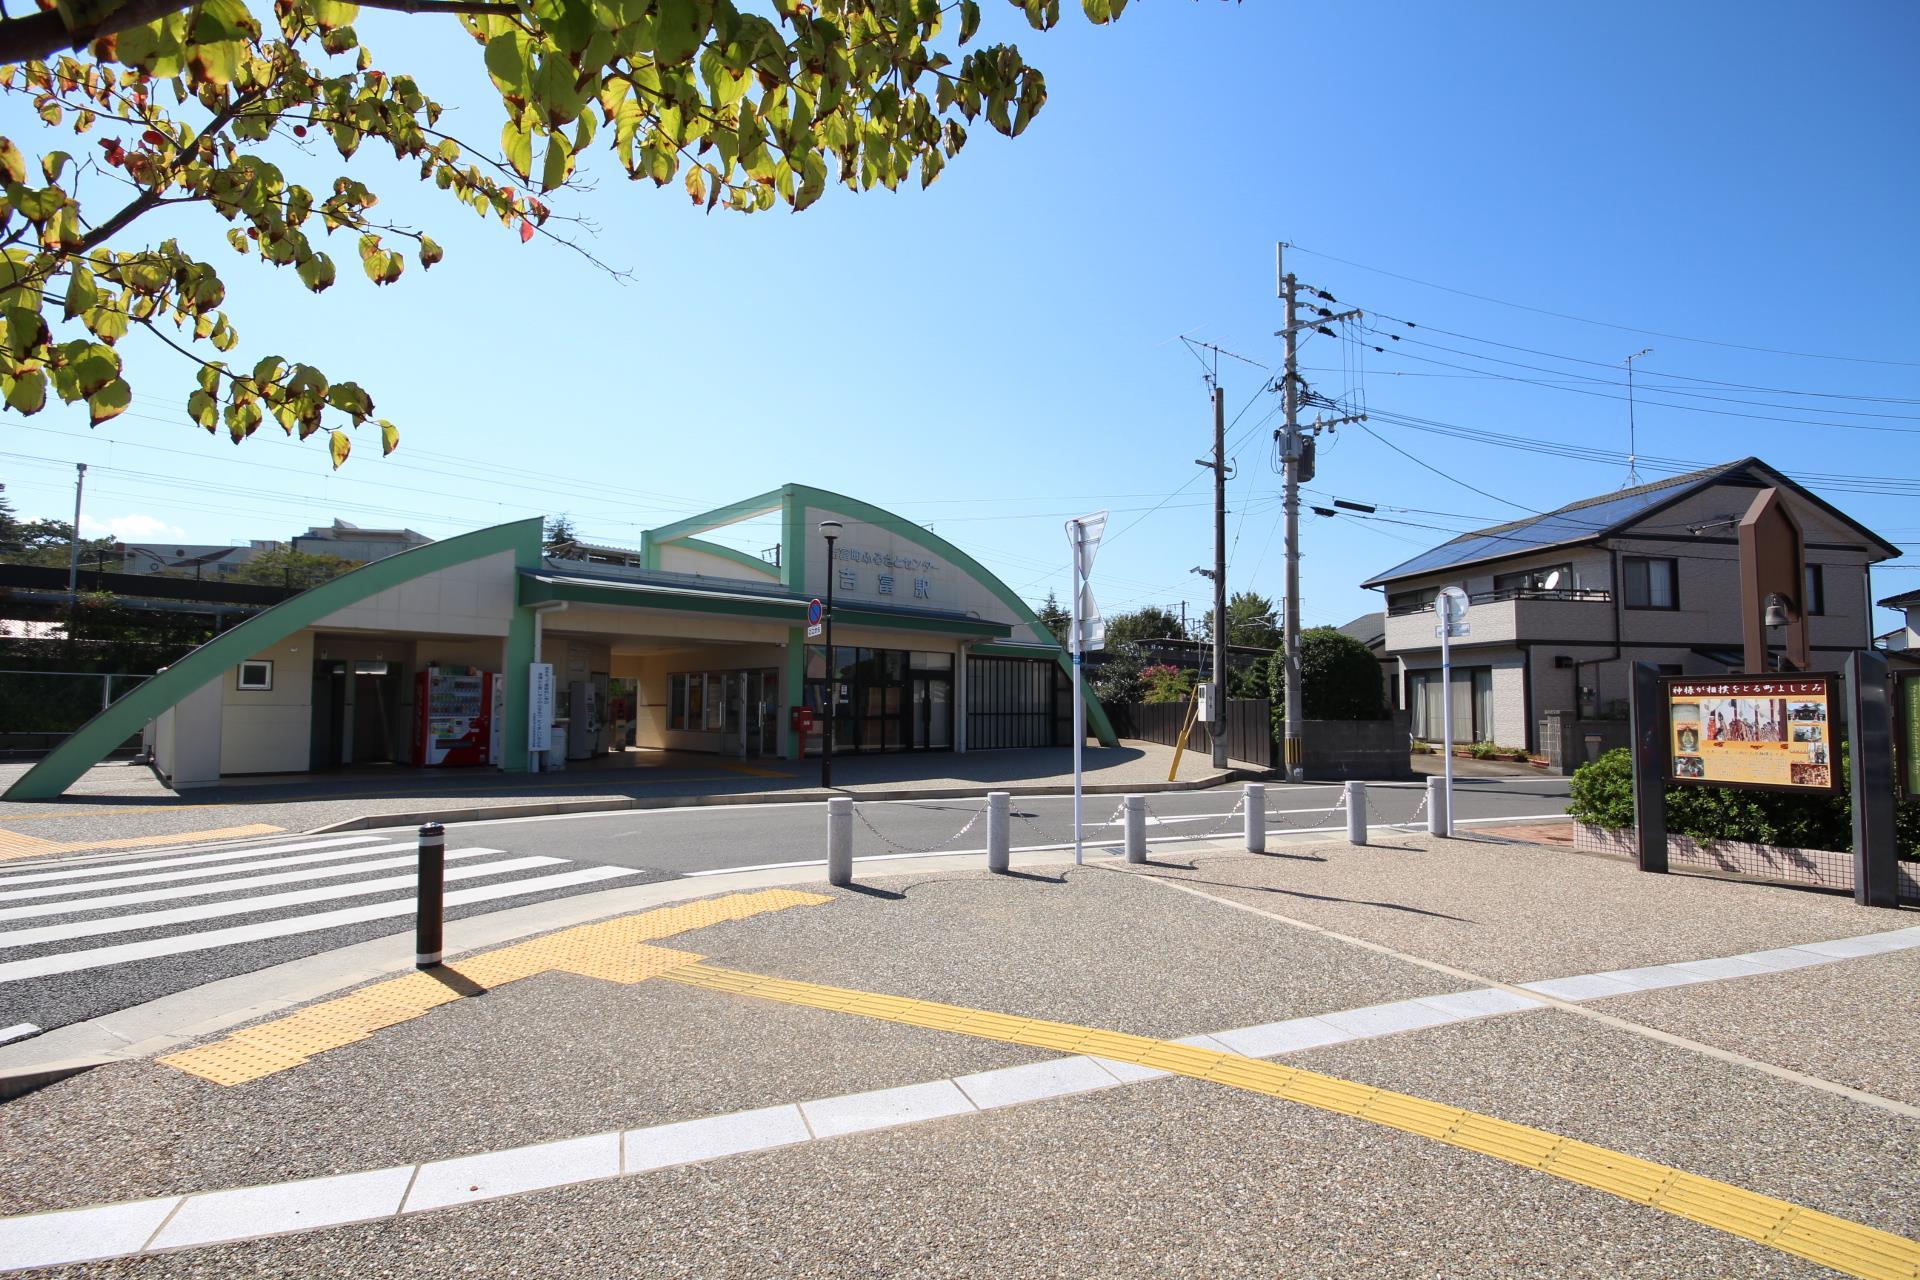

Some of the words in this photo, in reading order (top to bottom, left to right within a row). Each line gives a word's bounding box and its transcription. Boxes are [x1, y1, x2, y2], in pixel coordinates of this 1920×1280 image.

[839, 567, 930, 599] 吉富駅
[1672, 683, 1822, 695] 神様が相撲をとる町よしとみ
